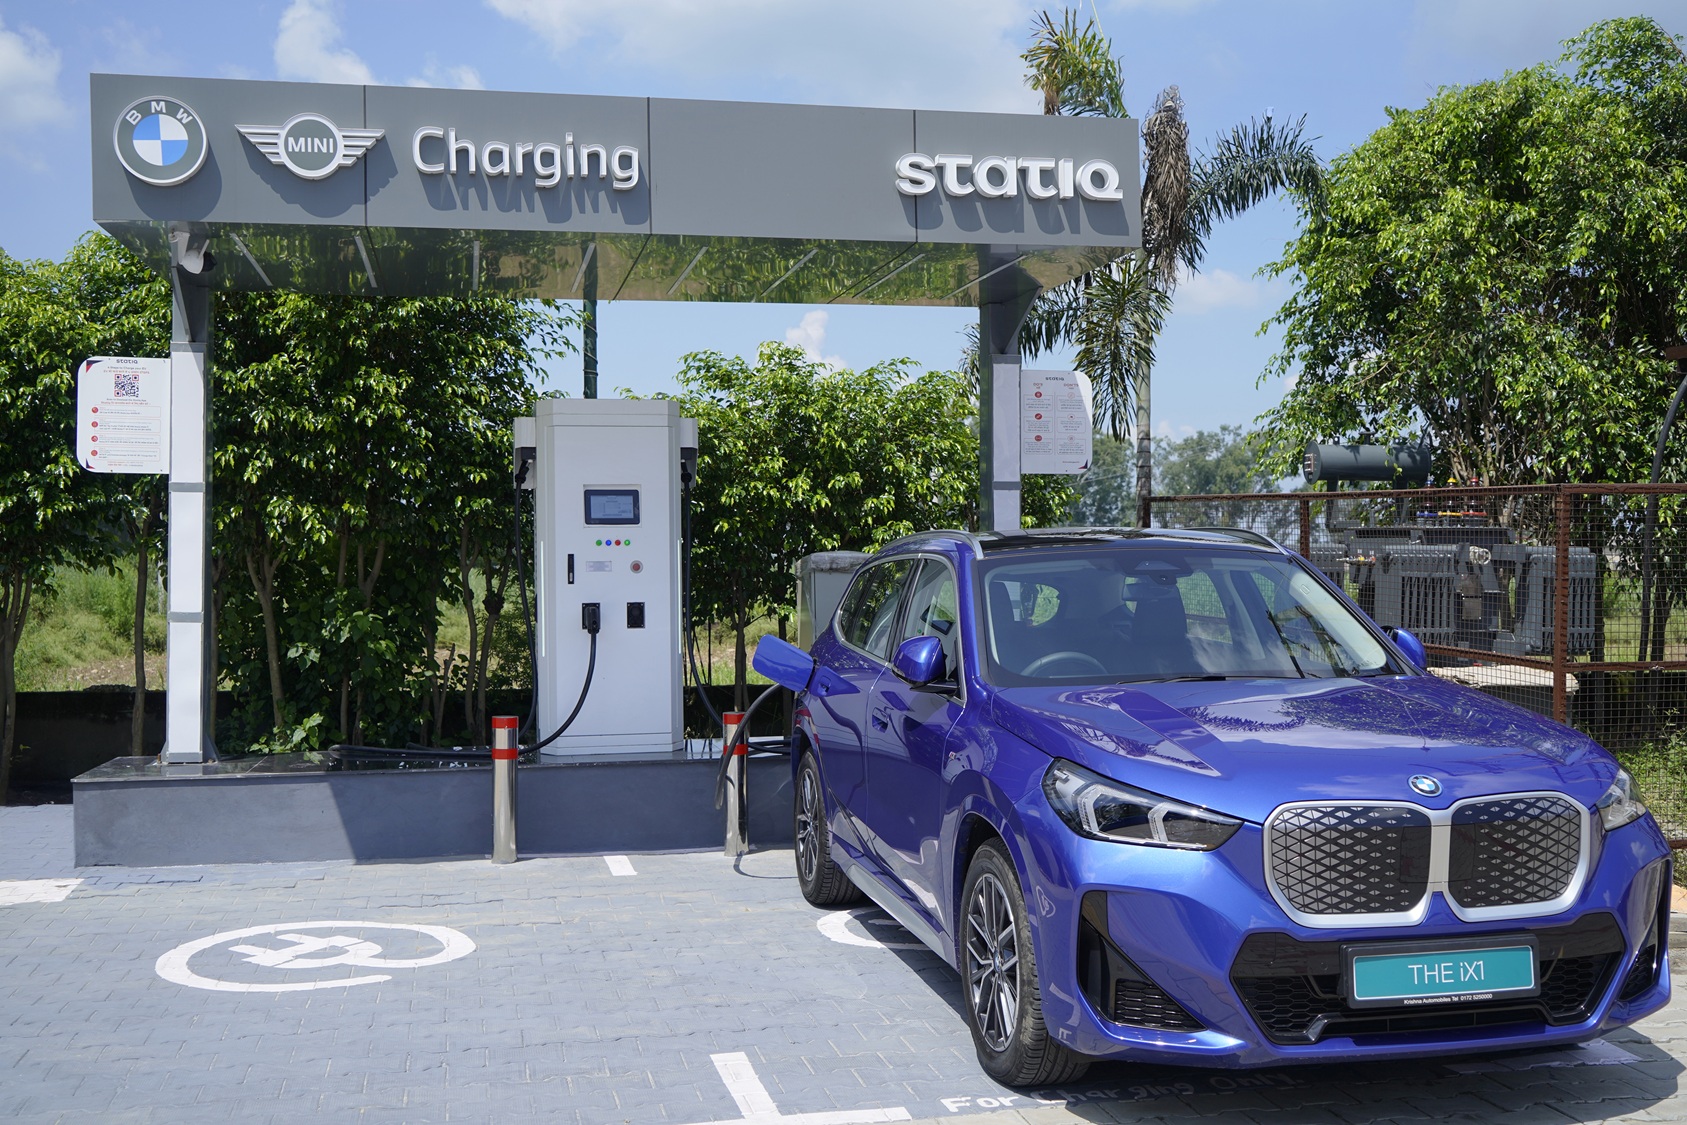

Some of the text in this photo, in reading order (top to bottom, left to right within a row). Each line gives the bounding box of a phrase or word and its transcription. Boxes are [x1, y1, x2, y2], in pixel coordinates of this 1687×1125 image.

[125, 100, 193, 126] BMW
[287, 136, 335, 154] MINI
[412, 126, 639, 190] Charging
[1408, 961, 1485, 984] THE iX1
[941, 1093, 1019, 1113] For
